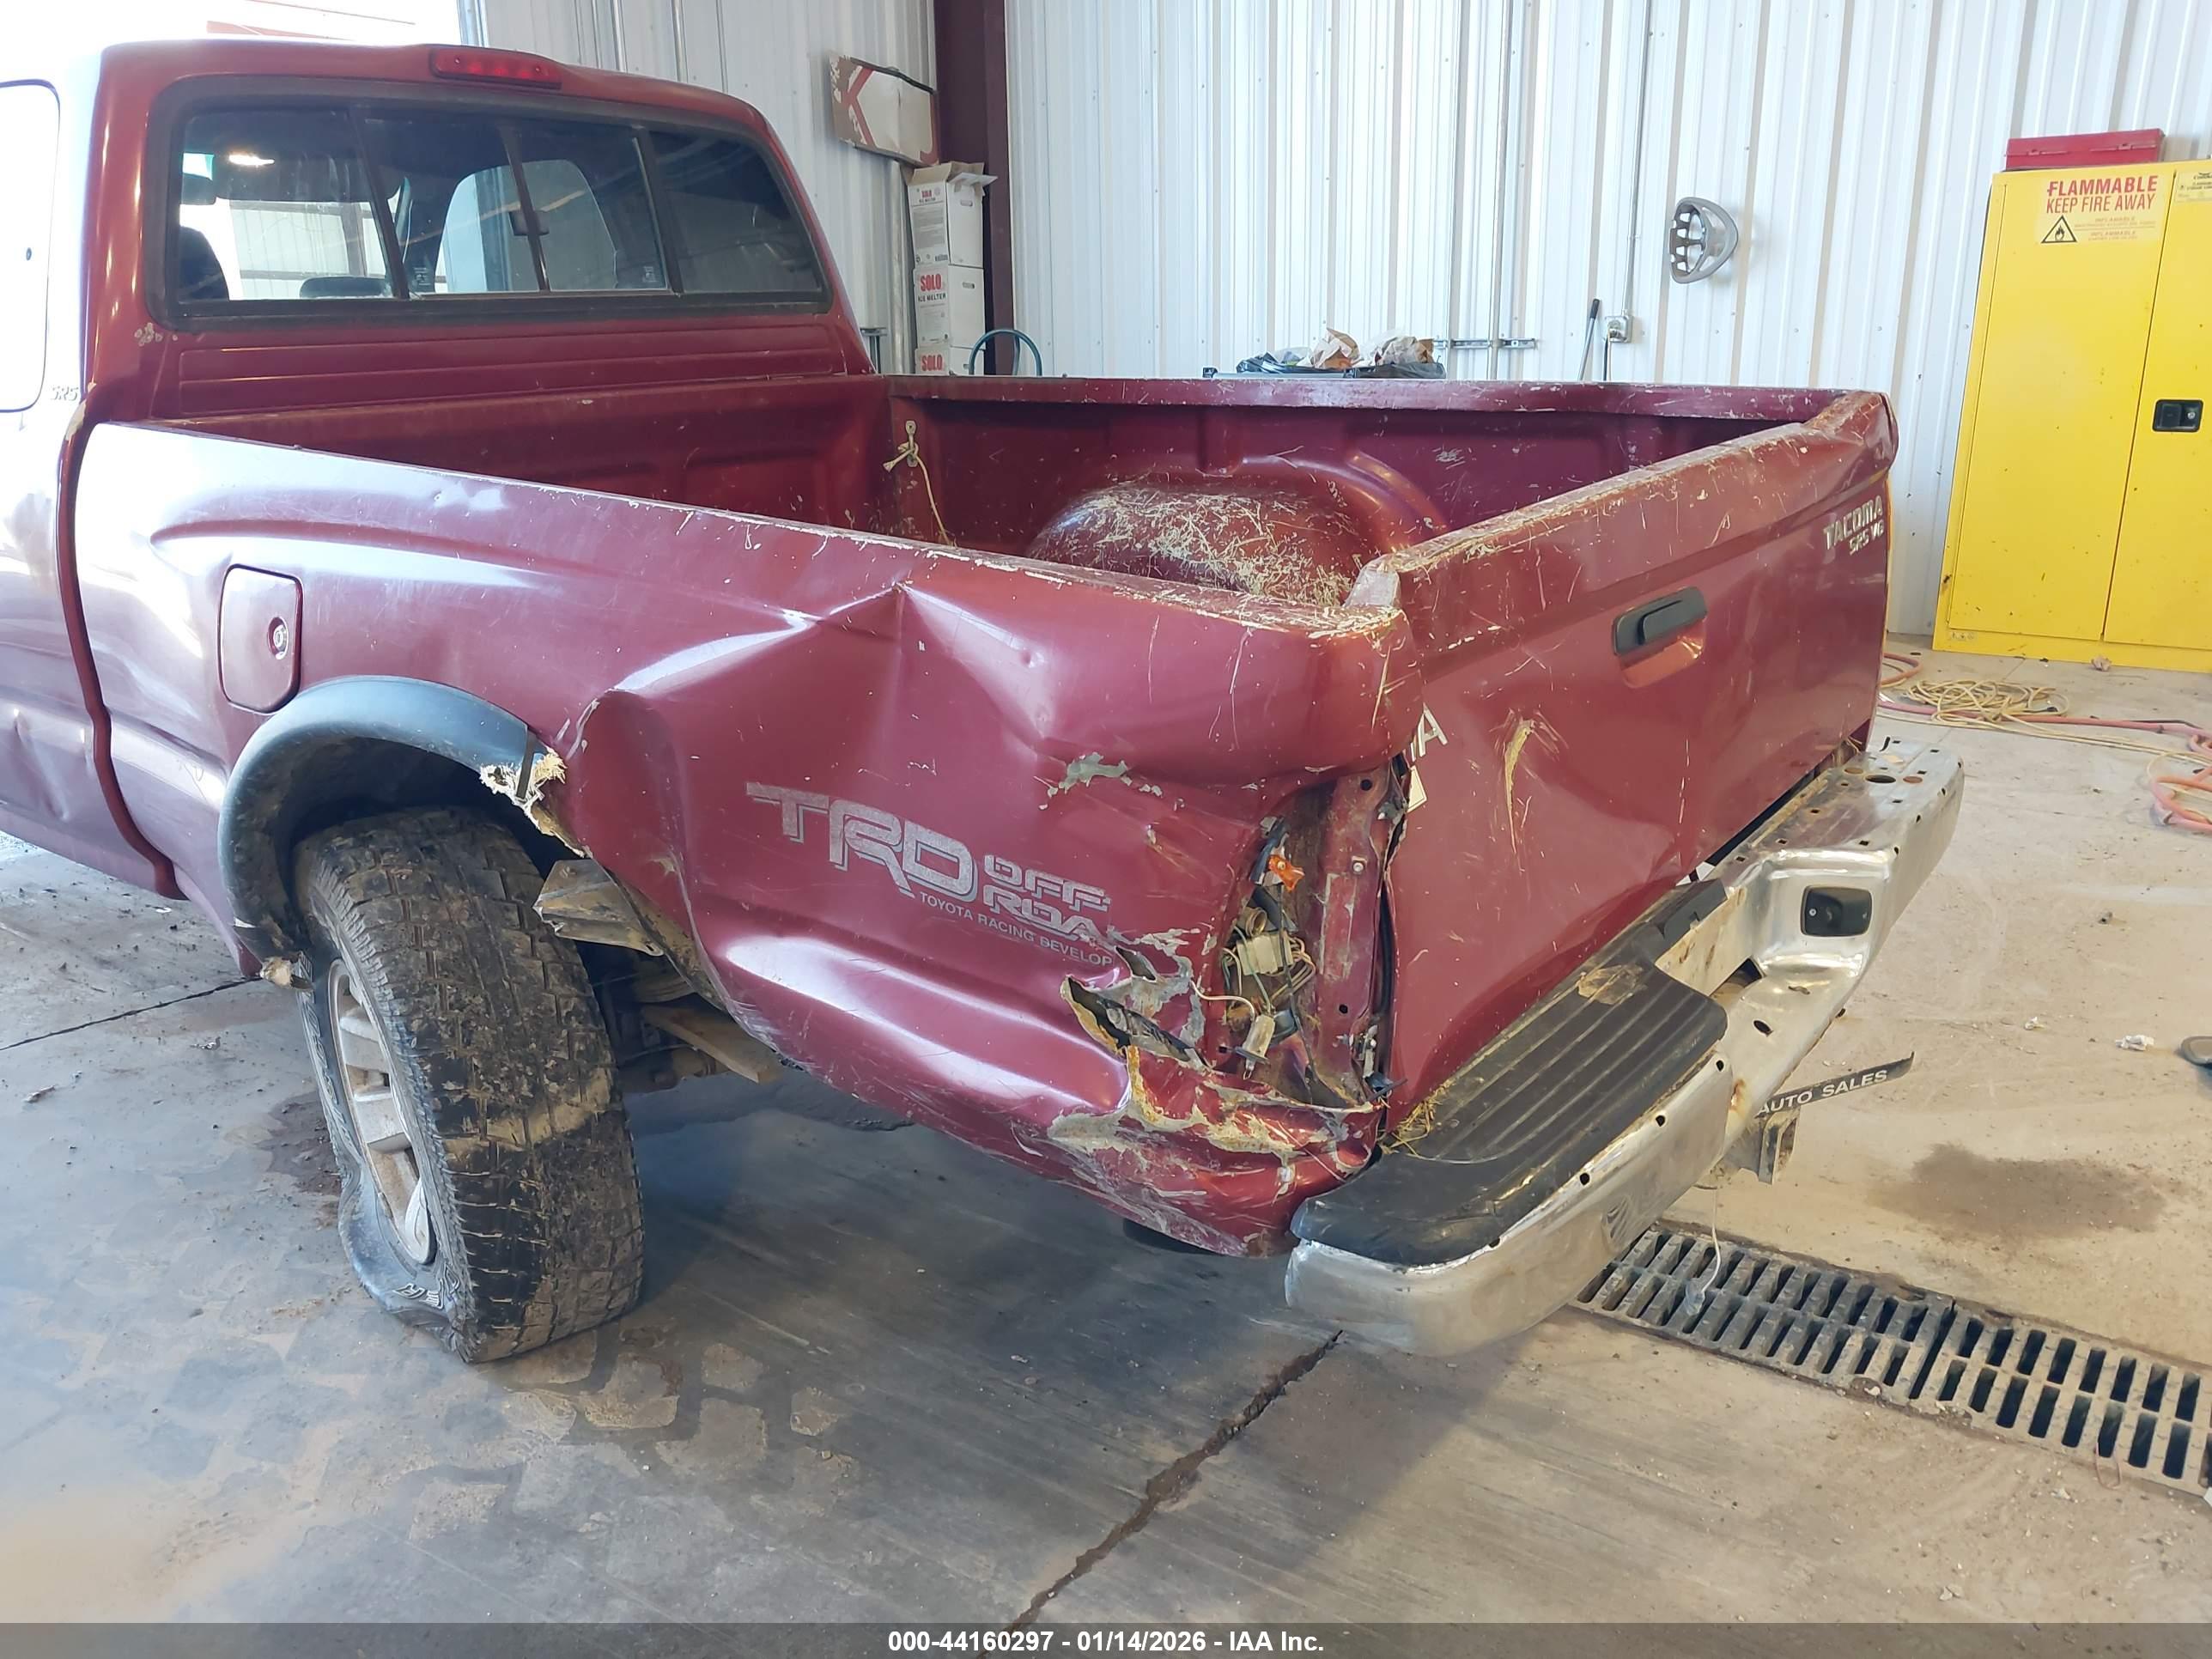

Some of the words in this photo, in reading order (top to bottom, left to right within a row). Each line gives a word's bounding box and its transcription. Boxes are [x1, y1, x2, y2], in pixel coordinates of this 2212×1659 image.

[2047, 175, 2158, 197] FLAMMABLE
[2046, 197, 2078, 214] KEEP
[2081, 196, 2111, 213] FIRE
[2114, 193, 2155, 211] AWAY
[920, 274, 942, 292] SOLO
[927, 292, 946, 301] MELTER
[921, 354, 943, 372] SOLO
[1823, 495, 1883, 550] TACOMA
[745, 782, 978, 902] TRD
[984, 854, 1112, 912] OFF
[920, 891, 974, 921] TOYOTA
[977, 913, 1036, 942] RACING
[1758, 1090, 1814, 1115] AUTO
[1821, 1069, 1888, 1098] SALES
